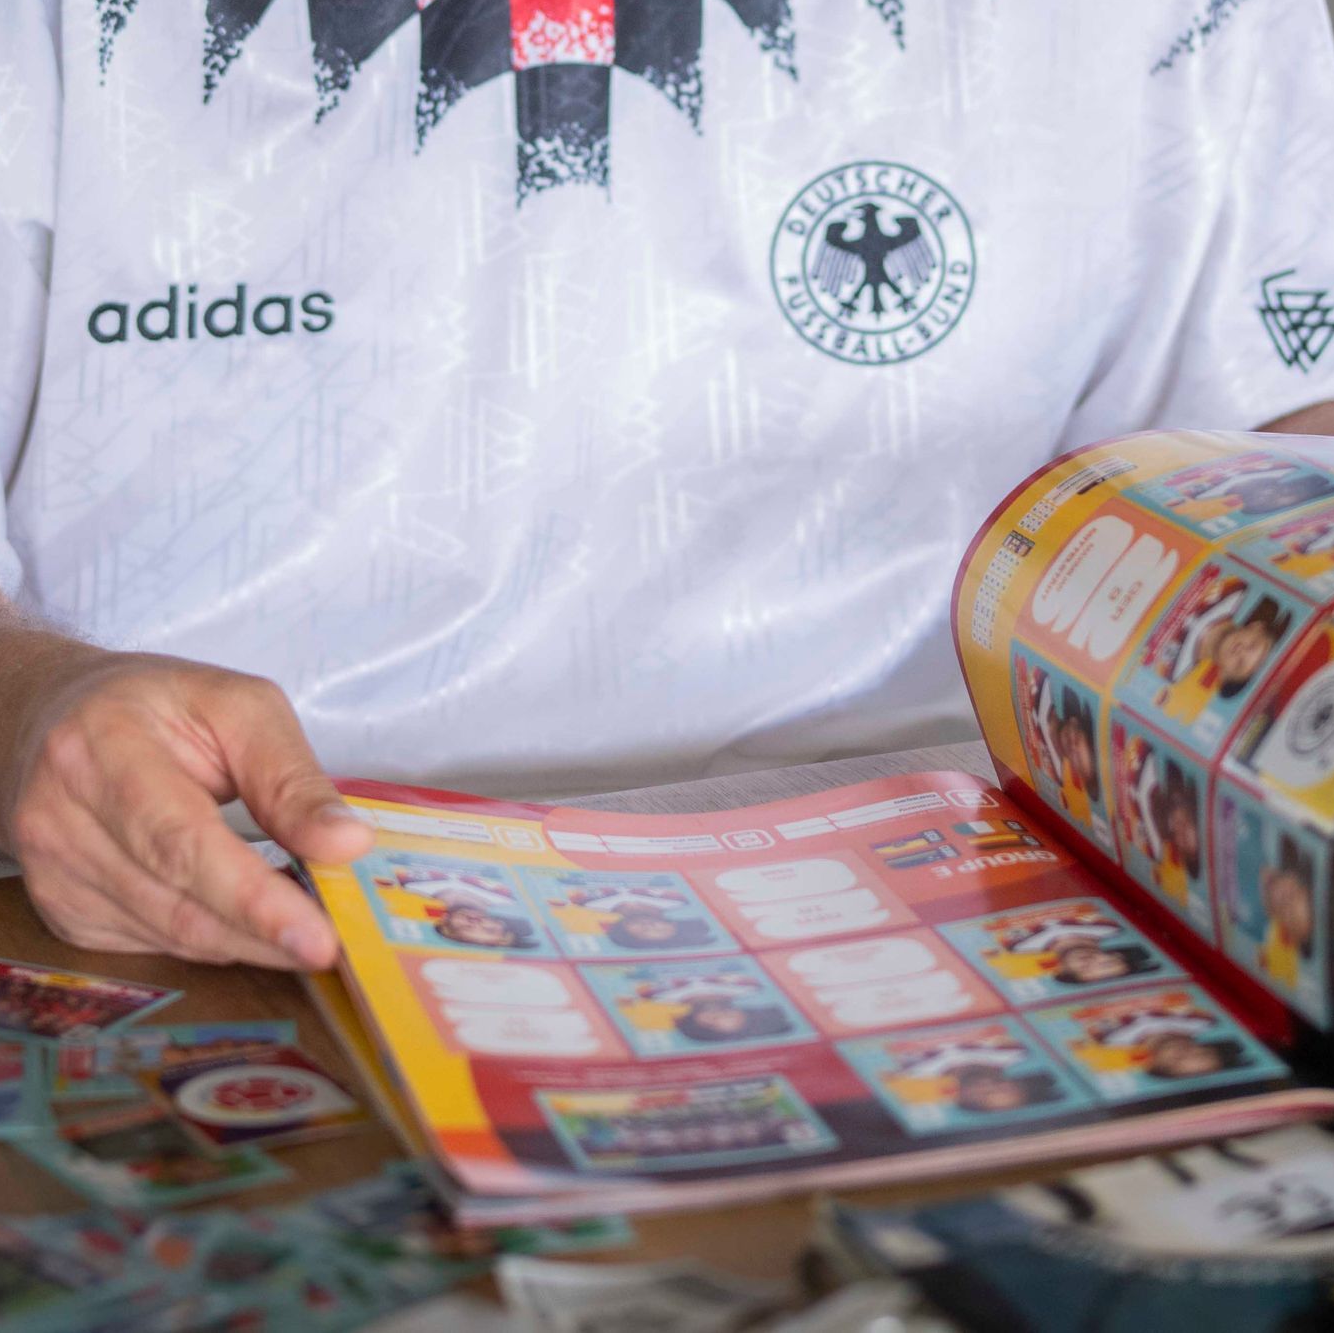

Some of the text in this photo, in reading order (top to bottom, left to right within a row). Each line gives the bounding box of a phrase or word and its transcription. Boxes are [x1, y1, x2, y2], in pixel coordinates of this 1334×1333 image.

[785, 167, 952, 236] DEUTSCHER
[87, 283, 334, 345] adidas
[930, 849, 1059, 879] GROUP E
